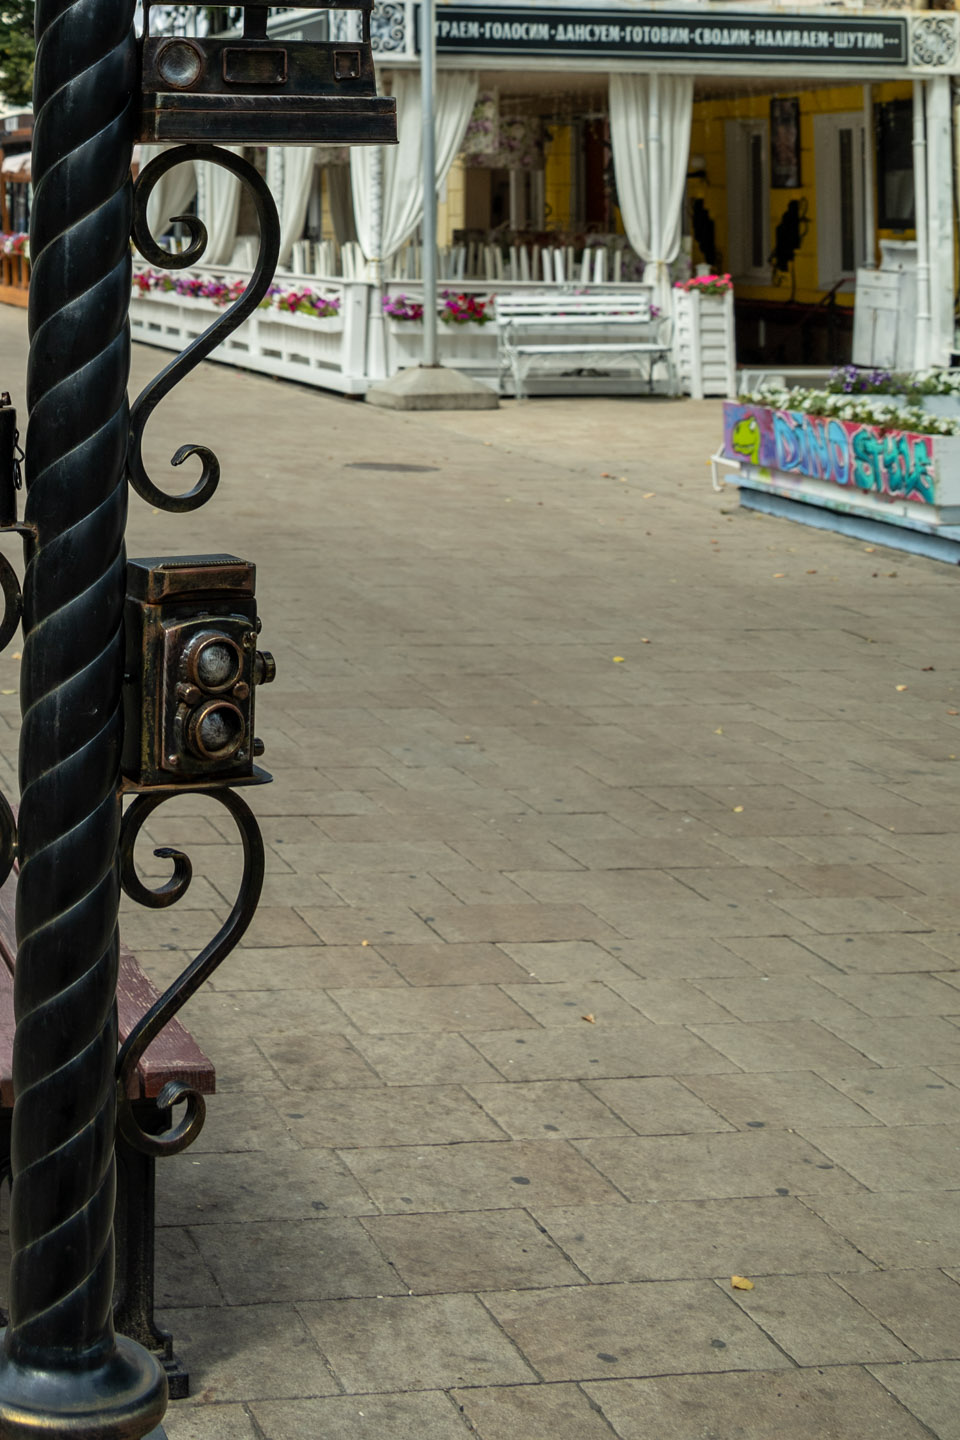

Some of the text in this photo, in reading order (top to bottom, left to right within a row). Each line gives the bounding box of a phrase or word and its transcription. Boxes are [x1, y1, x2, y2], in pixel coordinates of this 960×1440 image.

[435, 20, 480, 39] ГРАЕМ
[485, 22, 550, 41] ГОЛОСИМ
[625, 25, 690, 44] ГОТОВИМ
[755, 29, 830, 48] НАЛИВАЕМ
